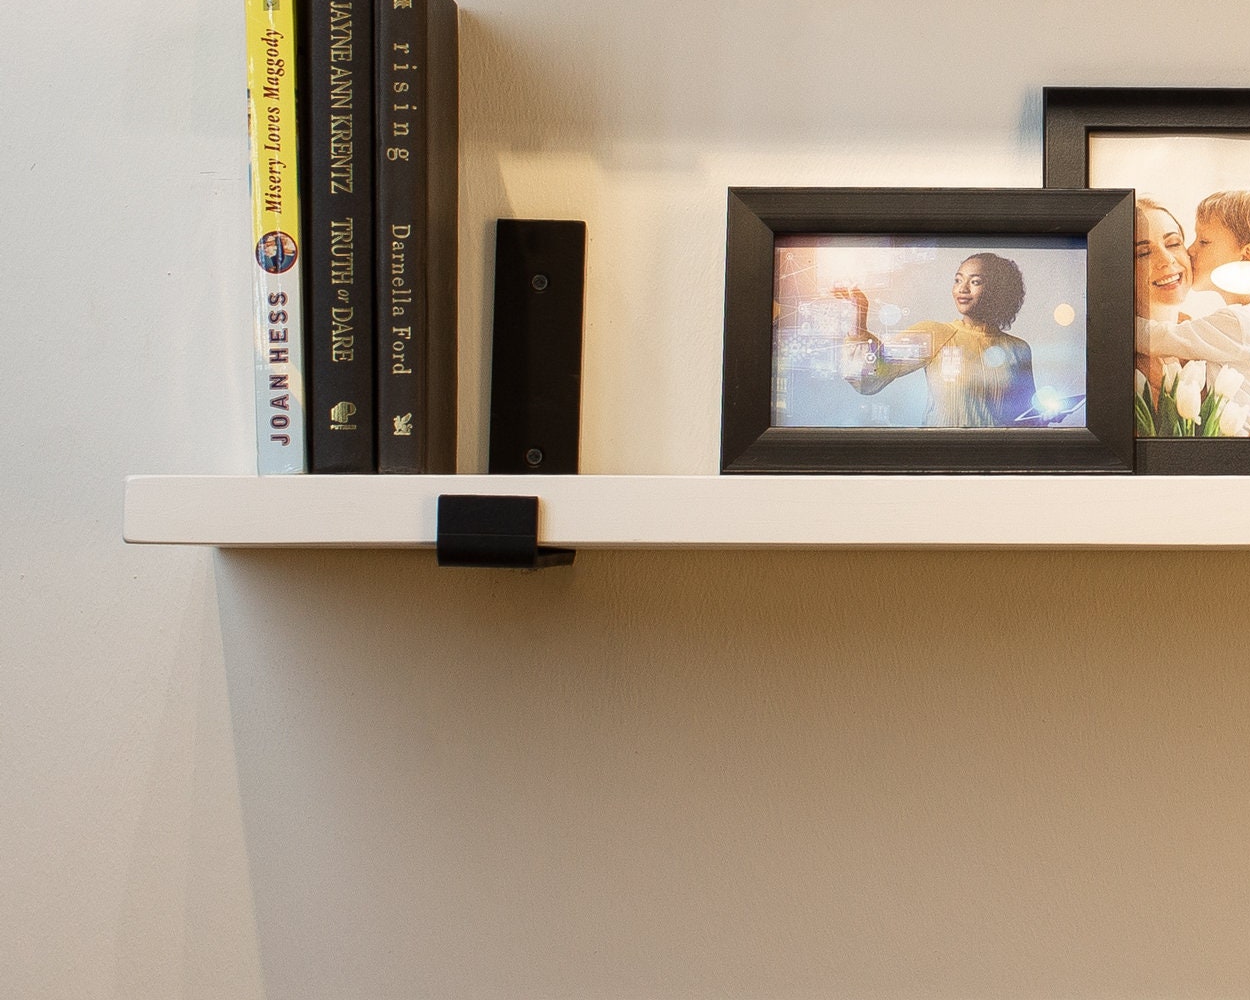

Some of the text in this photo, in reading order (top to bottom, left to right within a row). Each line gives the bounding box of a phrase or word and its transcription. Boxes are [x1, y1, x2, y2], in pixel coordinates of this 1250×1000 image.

[261, 28, 287, 214] Misery Loves Maggody
[330, 1, 353, 194] JAYNE ANN KRENTZ
[386, 43, 417, 161] rising
[331, 217, 354, 363] TRUTH or DARE
[392, 224, 412, 375] Darnella Ford
[268, 291, 290, 447] JOAN HESS
